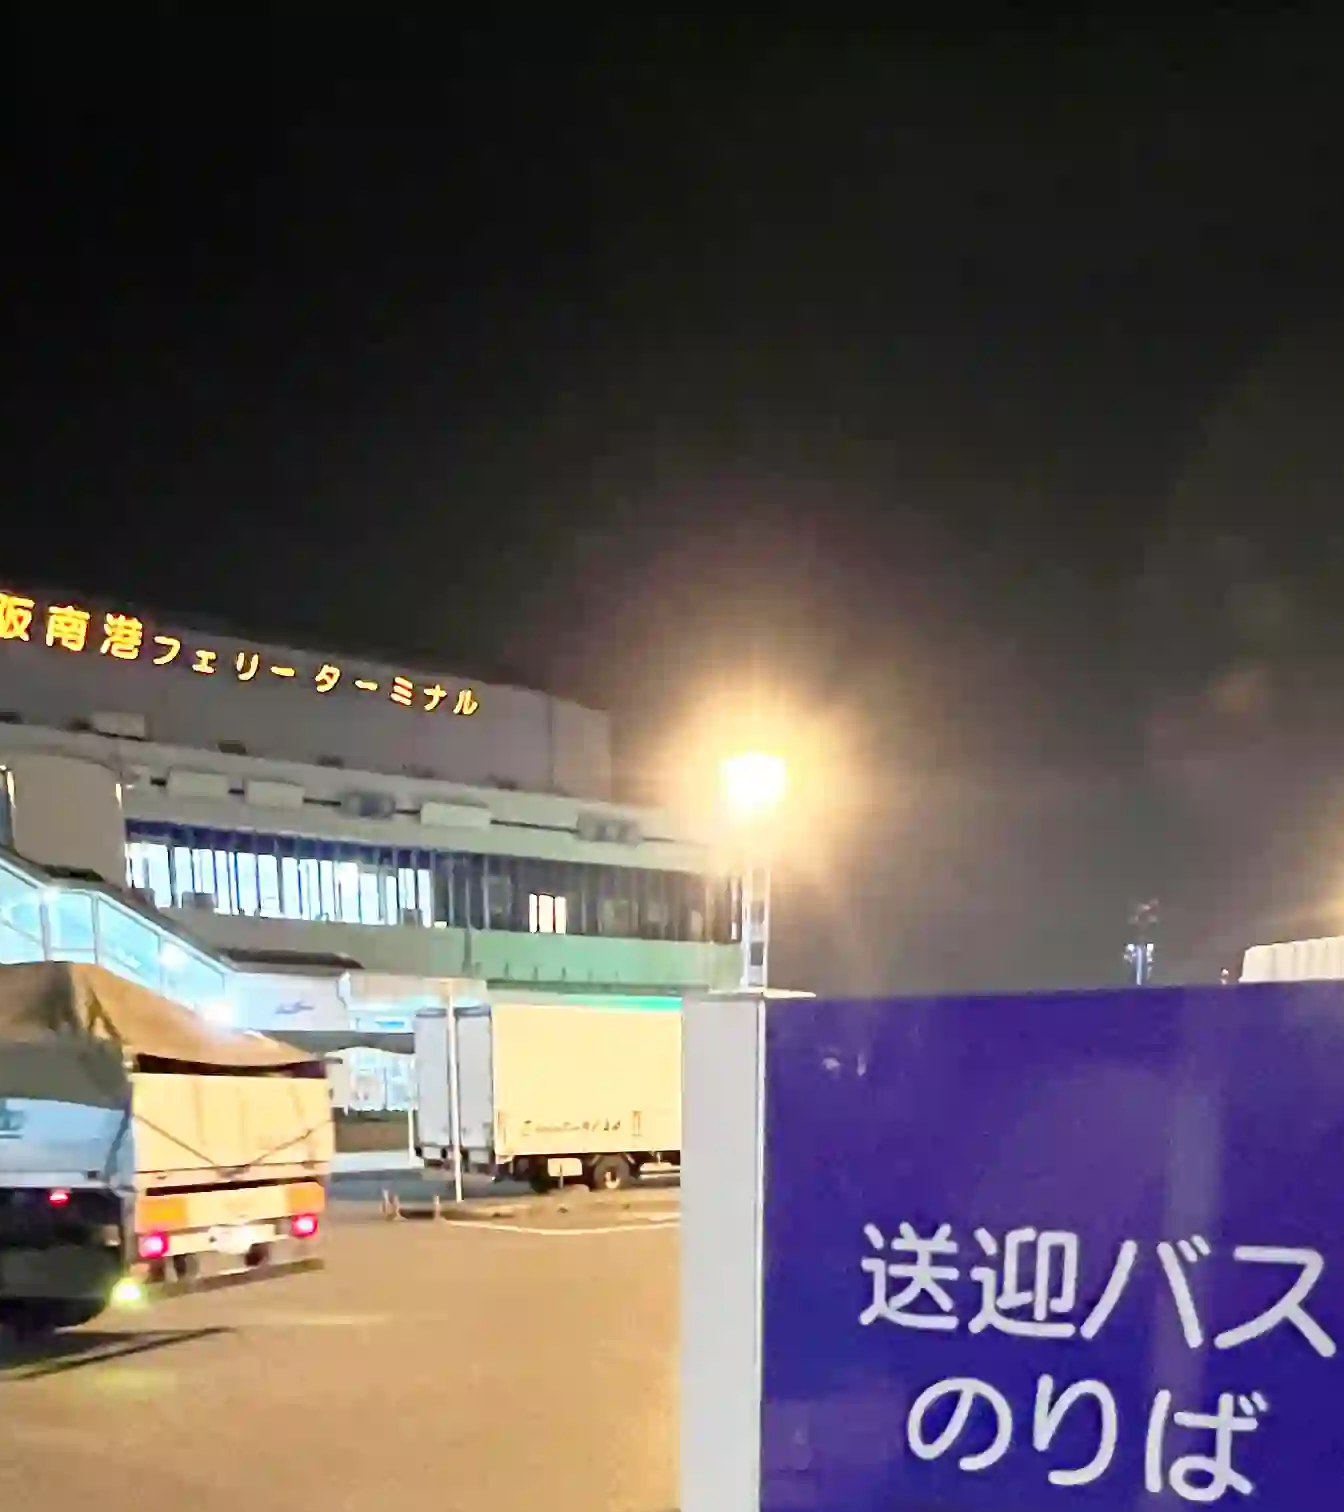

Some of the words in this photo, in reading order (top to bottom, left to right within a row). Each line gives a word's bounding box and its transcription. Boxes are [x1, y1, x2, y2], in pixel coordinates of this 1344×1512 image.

[859, 1221, 1337, 1358] 送迎バス
[907, 1373, 1268, 1502] のりば
